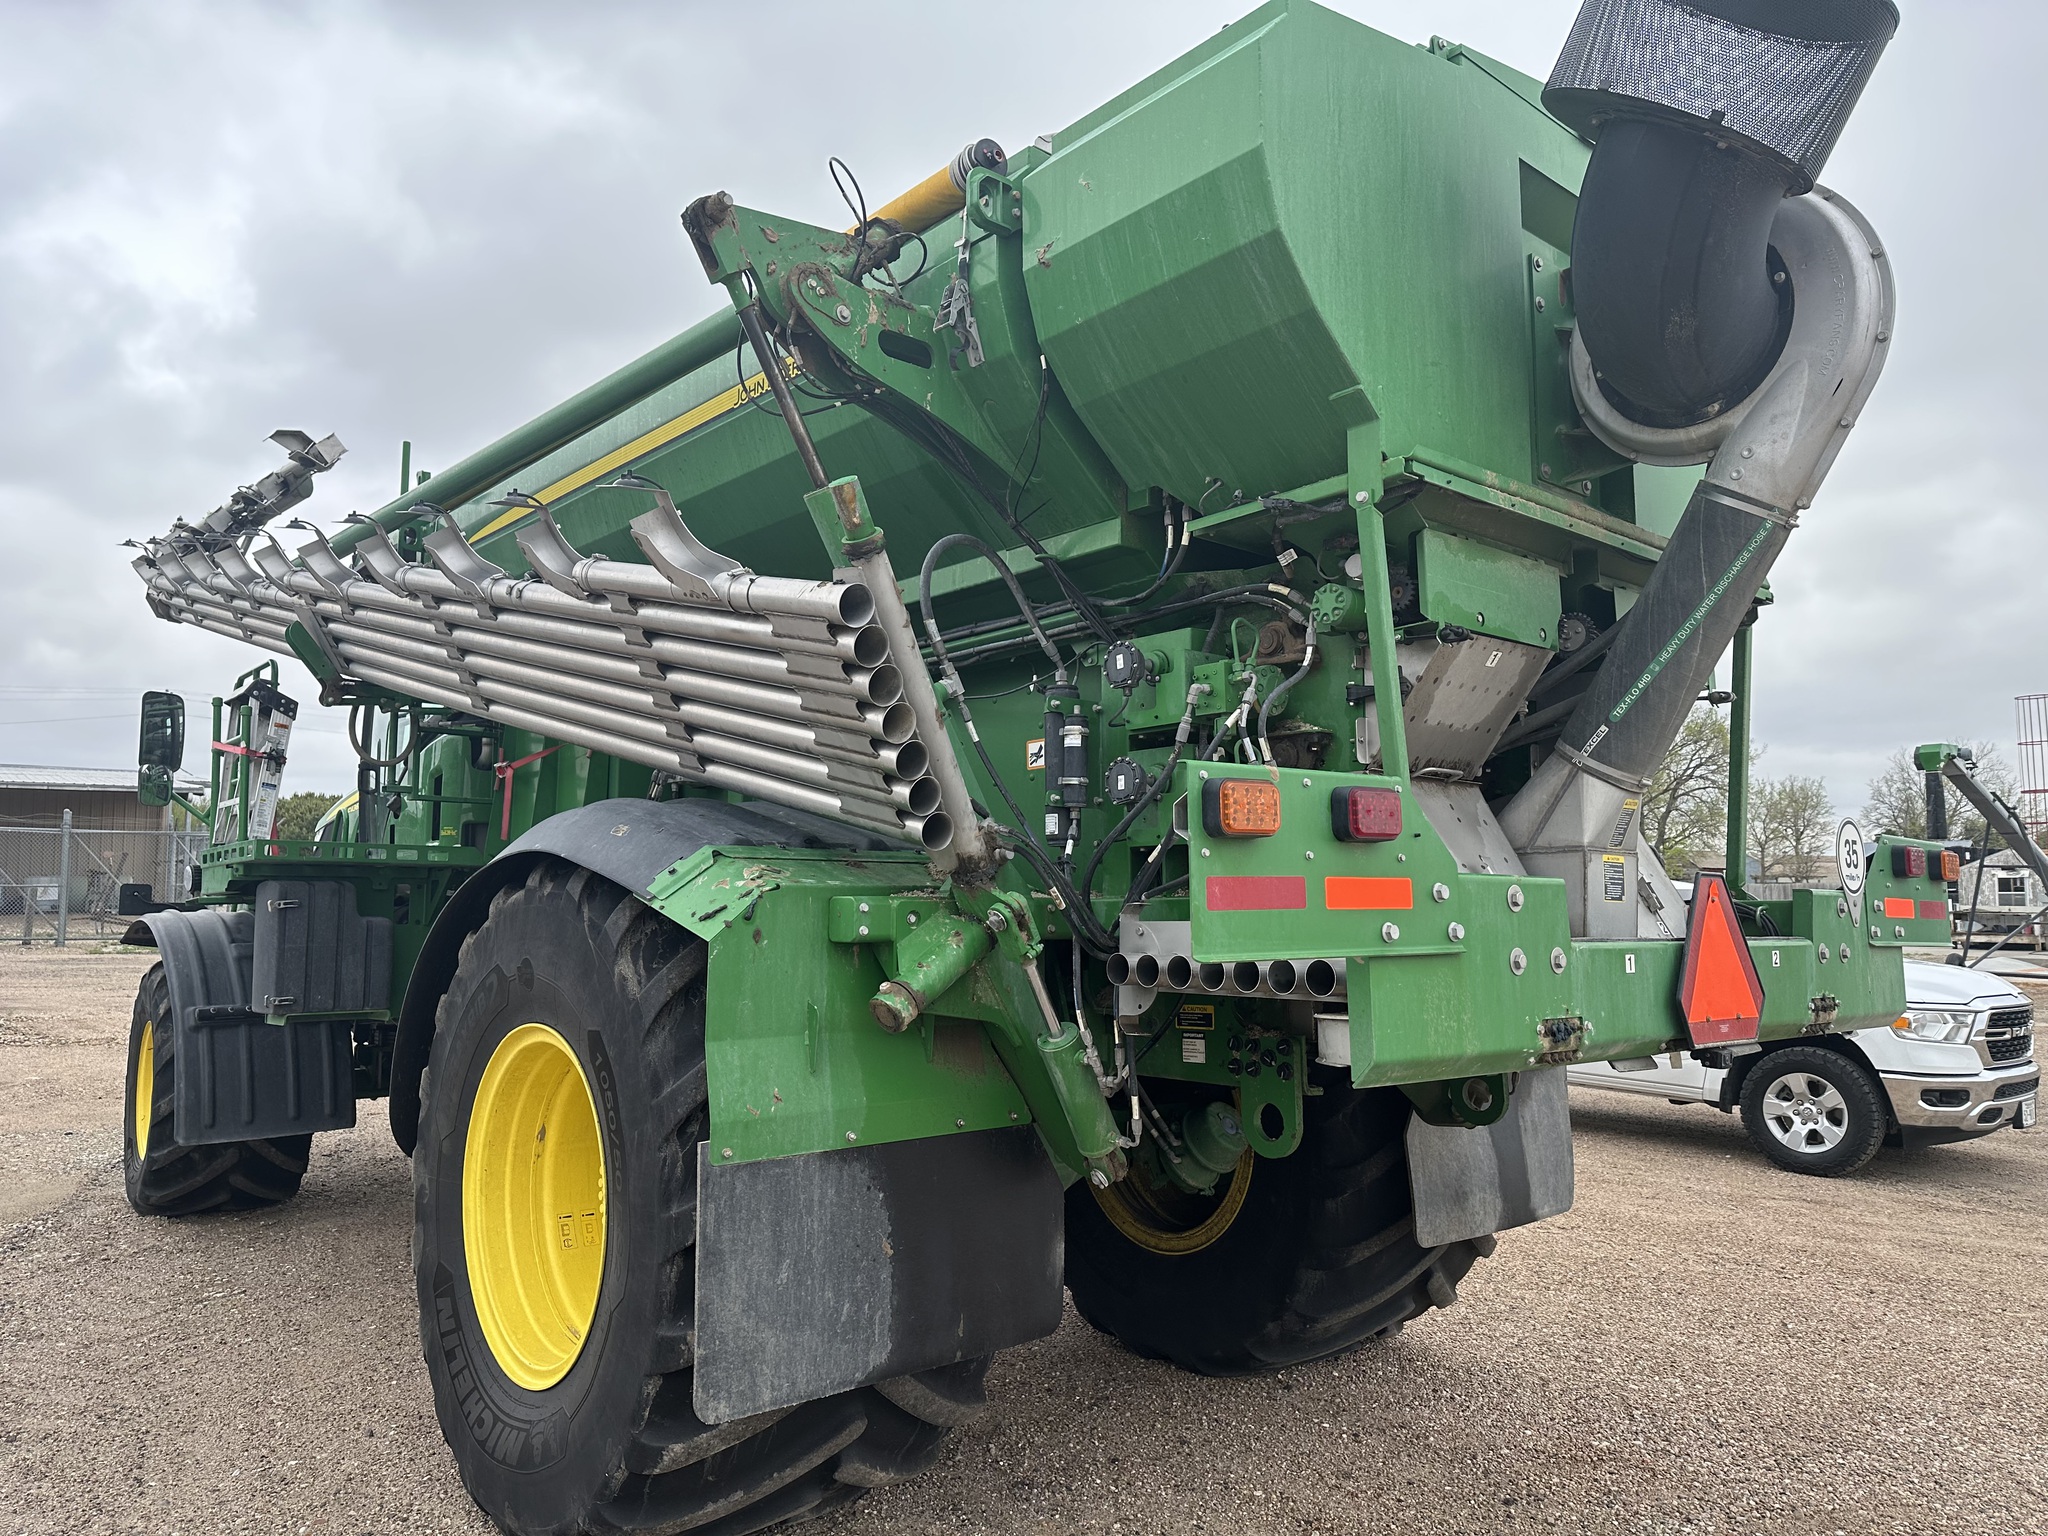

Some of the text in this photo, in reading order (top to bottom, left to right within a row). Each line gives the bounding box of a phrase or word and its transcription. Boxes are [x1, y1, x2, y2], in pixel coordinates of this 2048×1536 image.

[734, 378, 765, 407] JOHN
[1612, 688, 1640, 717] TEX-FLO
[1638, 673, 1652, 689] 4HD
[1659, 638, 1681, 662] HEAVY
[1678, 618, 1697, 639] DUTY
[1693, 593, 1719, 620] WATER
[1714, 551, 1751, 594] DISCHARGE
[1749, 529, 1768, 551] HOSE
[1490, 652, 1498, 665] 1
[1580, 729, 1607, 755] EXCEL
[1844, 838, 1859, 870] 35
[1845, 873, 1861, 882] mile/h
[1627, 956, 1633, 971] 1
[1773, 952, 1779, 965] 2
[435, 1297, 527, 1466] MICHELIN
